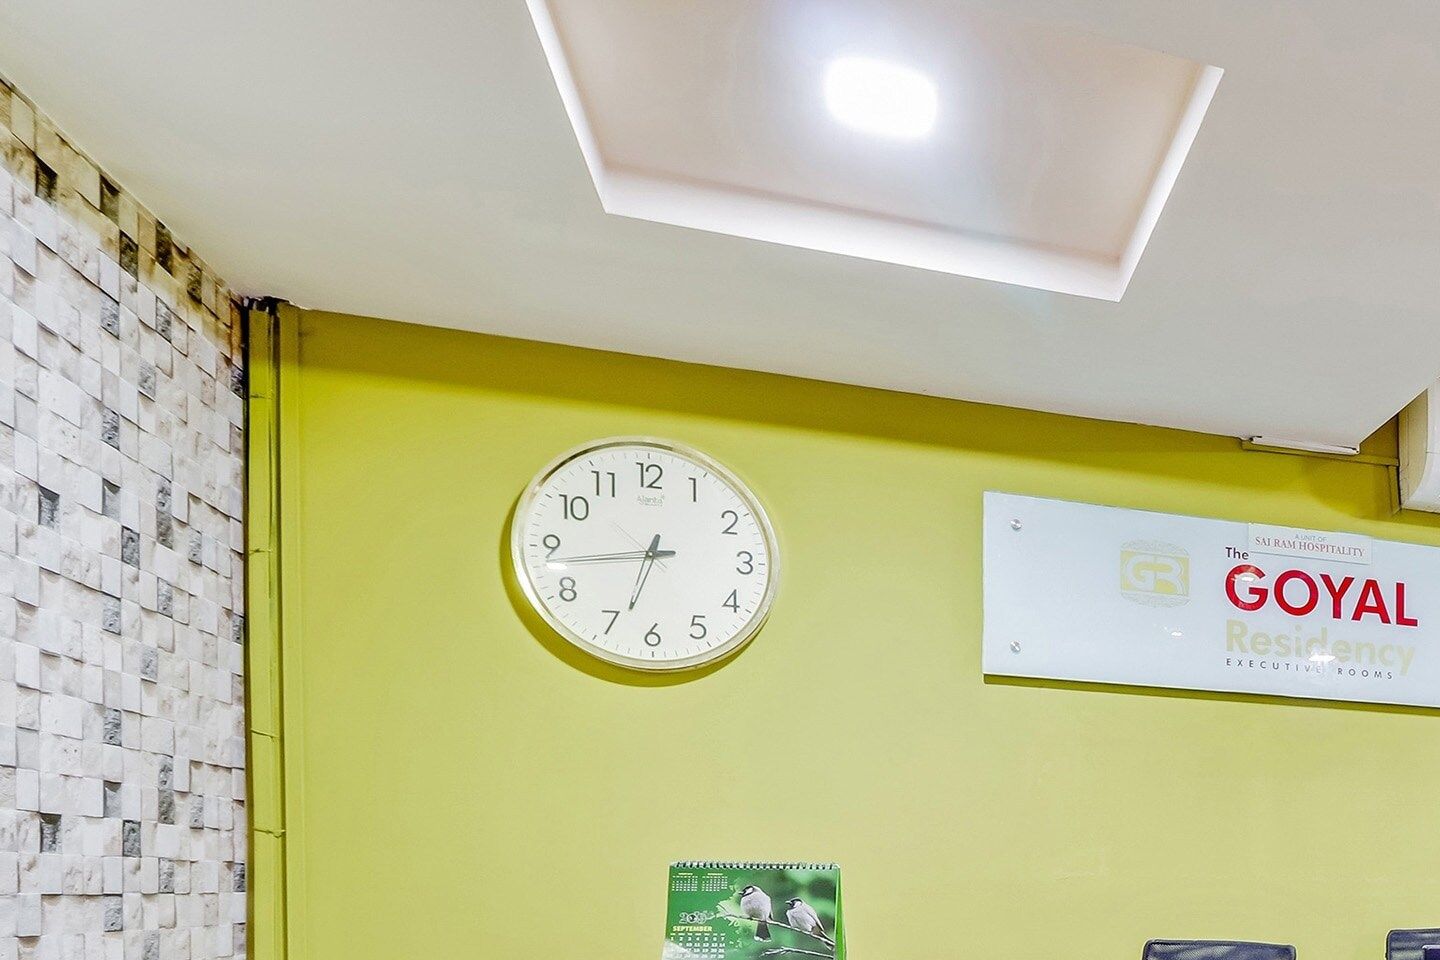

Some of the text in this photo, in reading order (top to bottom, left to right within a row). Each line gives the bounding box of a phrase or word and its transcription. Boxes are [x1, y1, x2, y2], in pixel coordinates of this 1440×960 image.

[591, 470, 616, 497] 11
[636, 462, 663, 489] 12
[688, 477, 697, 502] 1
[559, 494, 589, 521] 10
[721, 510, 738, 535] 2
[542, 534, 560, 561] 9
[1225, 546, 1249, 560] The
[1255, 536, 1365, 557] SAI RAM HOSPITALITY
[736, 551, 753, 575] 3
[559, 577, 577, 601] 8
[722, 589, 740, 613] 4
[1225, 564, 1419, 628] GOYAL
[601, 610, 620, 634] 7
[689, 615, 707, 639] 5
[644, 623, 661, 646] 6
[1226, 618, 1416, 677] Residency
[1226, 658, 1393, 680] EXECUTIVE ROOMS
